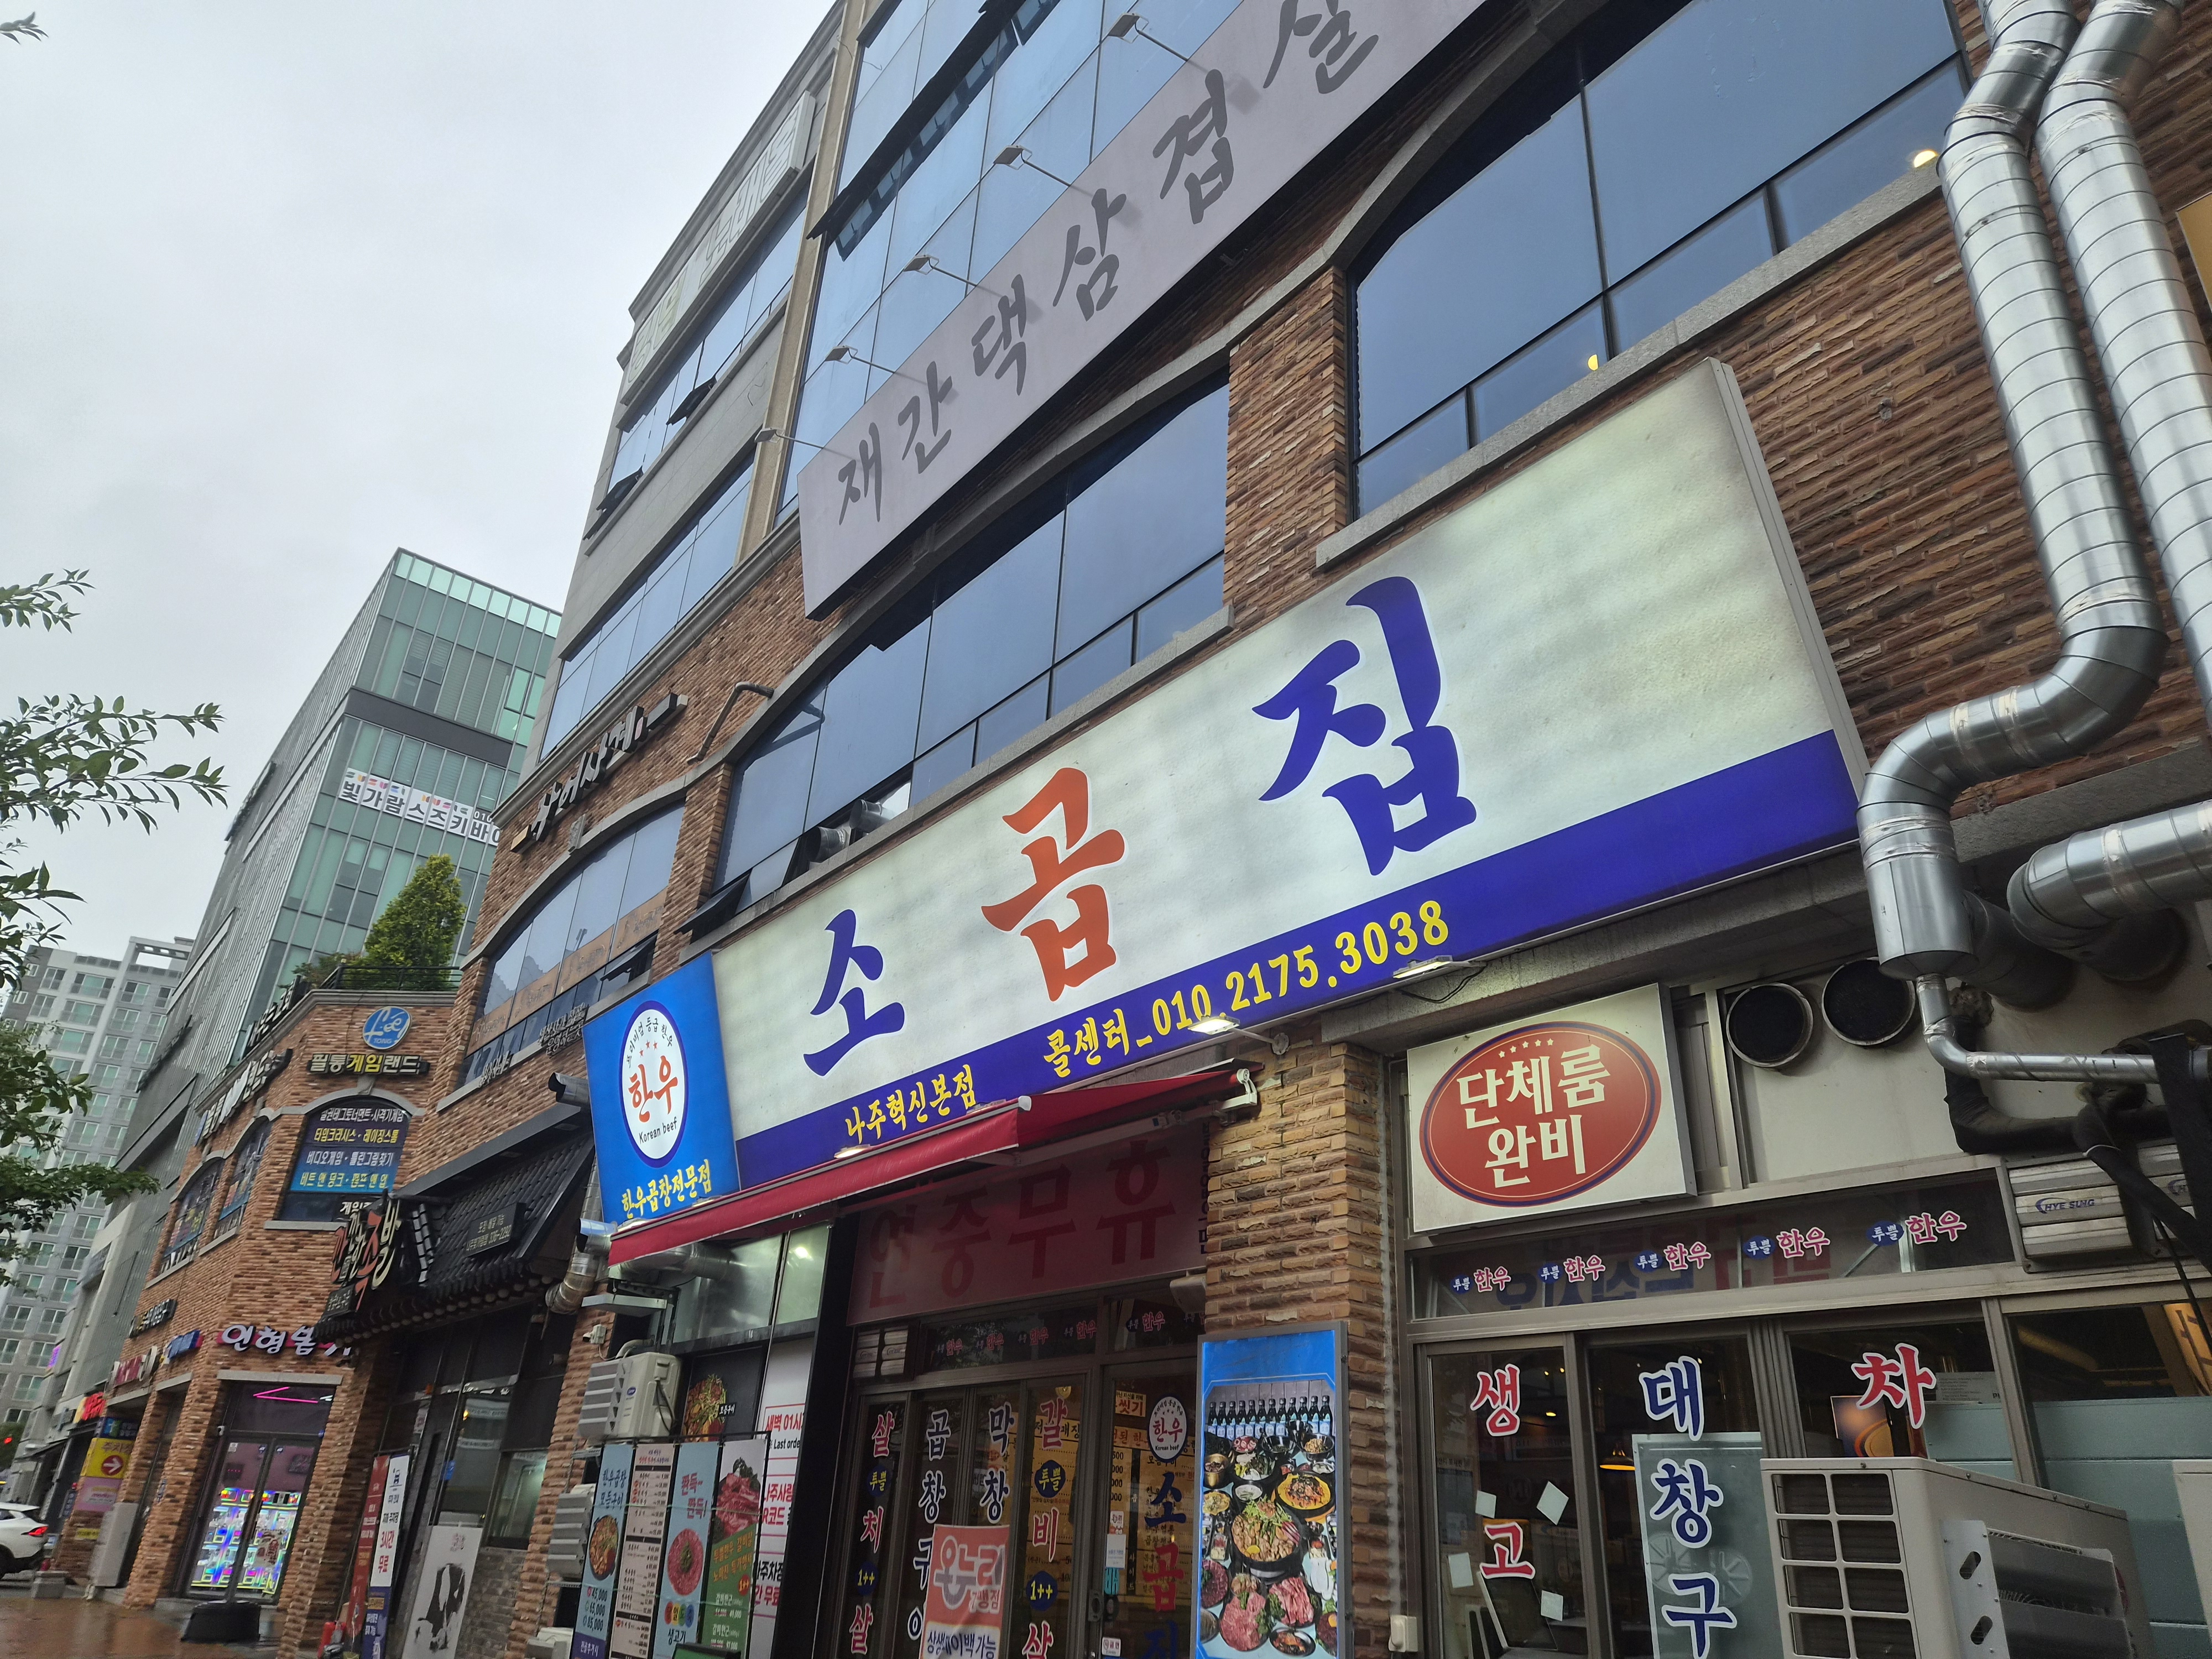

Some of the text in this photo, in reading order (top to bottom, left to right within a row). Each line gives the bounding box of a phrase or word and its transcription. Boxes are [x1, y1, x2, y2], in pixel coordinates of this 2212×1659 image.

[625, 1016, 673, 1068] 프리미엄 등급 한우
[310, 1053, 421, 1074] 필통게임랜드
[628, 1055, 678, 1123] 한우
[1457, 1044, 1611, 1129] 단체룸
[844, 1064, 979, 1144] 나주혁신본점
[639, 1116, 677, 1144] Korean beef
[1484, 1114, 1586, 1188] 완비
[622, 1159, 712, 1219] 한우곱창전문점
[1906, 1210, 1967, 1245] 한우
[1777, 1226, 1830, 1259] 한우
[1564, 1254, 1605, 1282] 한우
[1665, 1241, 1712, 1272] 한우
[1474, 1266, 1511, 1292] 한우
[1076, 1319, 1097, 1340] 한우
[1142, 1311, 1165, 1331] 한우
[946, 1339, 963, 1356] 한우
[987, 1332, 1004, 1350] 한우
[1030, 1327, 1048, 1346] 한우
[1851, 1342, 1937, 1430] 차
[766, 1414, 782, 1432] 새벽
[1153, 1417, 1183, 1443] 한우
[774, 1438, 800, 1449] Last orde
[857, 1569, 875, 1586] 1++
[933, 1536, 1006, 1610] 온누리
[1030, 1579, 1053, 1600] 1++
[667, 1629, 686, 1646] 생고기
[975, 1635, 997, 1659] 가능
